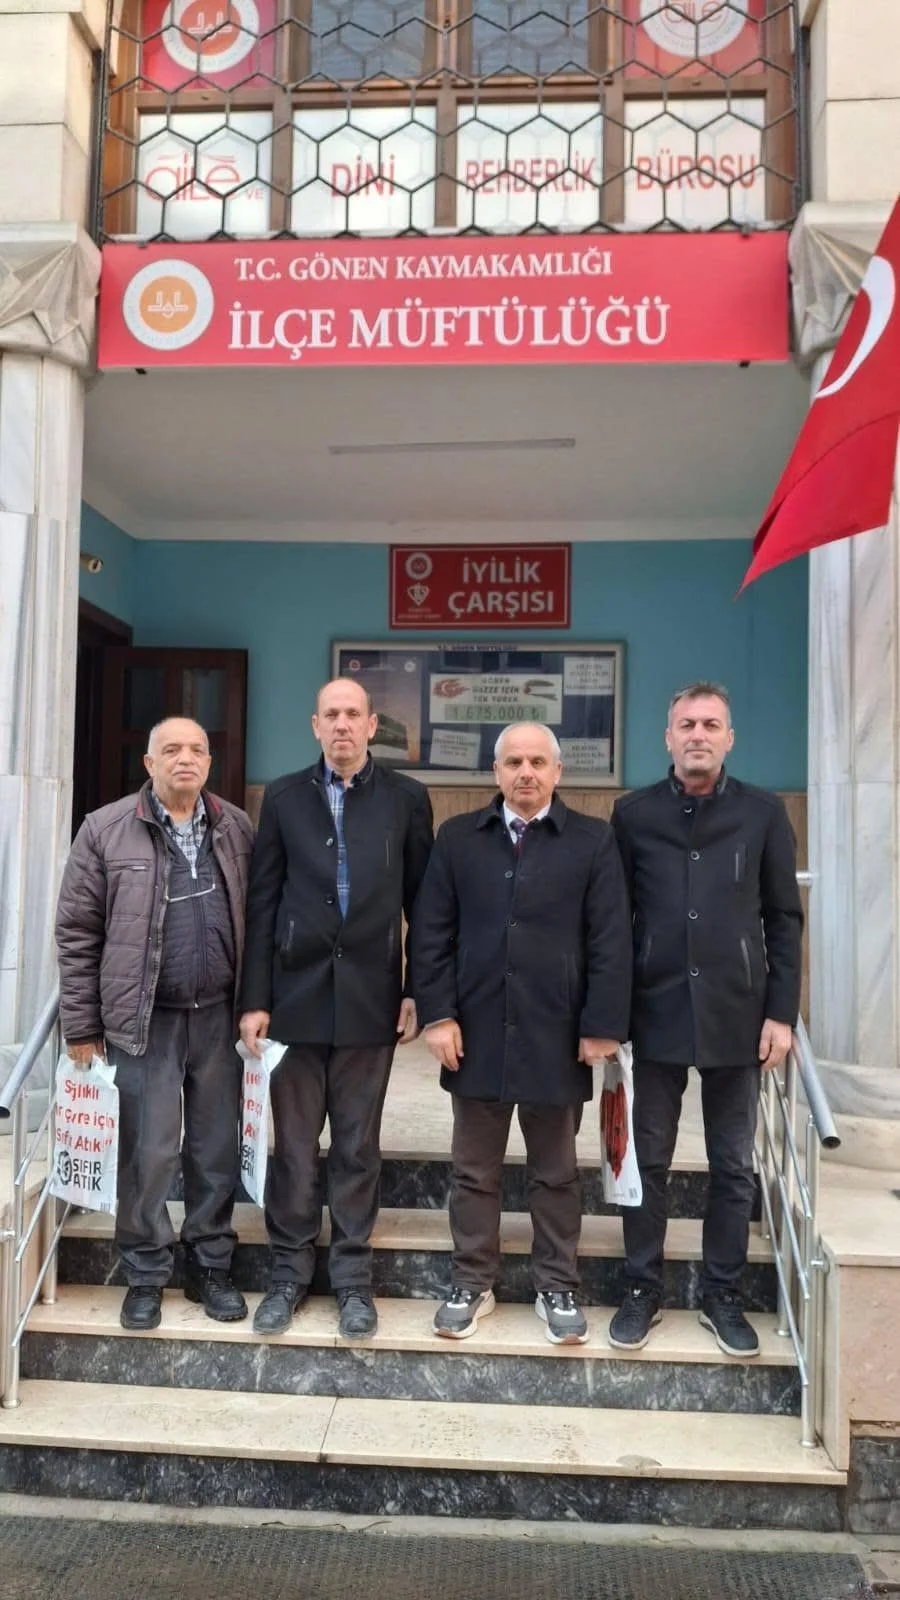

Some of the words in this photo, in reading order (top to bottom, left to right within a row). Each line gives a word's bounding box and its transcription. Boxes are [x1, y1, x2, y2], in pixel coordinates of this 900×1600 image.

[331, 154, 396, 198] DİNİ
[465, 150, 600, 194] REHBERLİK
[636, 149, 756, 191] BÜROSU
[234, 257, 281, 280] T.C.
[289, 253, 387, 280] GÖNEN
[395, 247, 612, 279] KAYMAKAMLIĞI
[228, 301, 337, 360] İLÇE
[348, 296, 671, 349] MÜFTÜLÜĞÜ
[462, 556, 542, 584] İYİLİK
[447, 591, 554, 618] ÇARŞISI
[72, 1158, 102, 1176] SIFIR
[73, 1173, 102, 1191] ATIK
